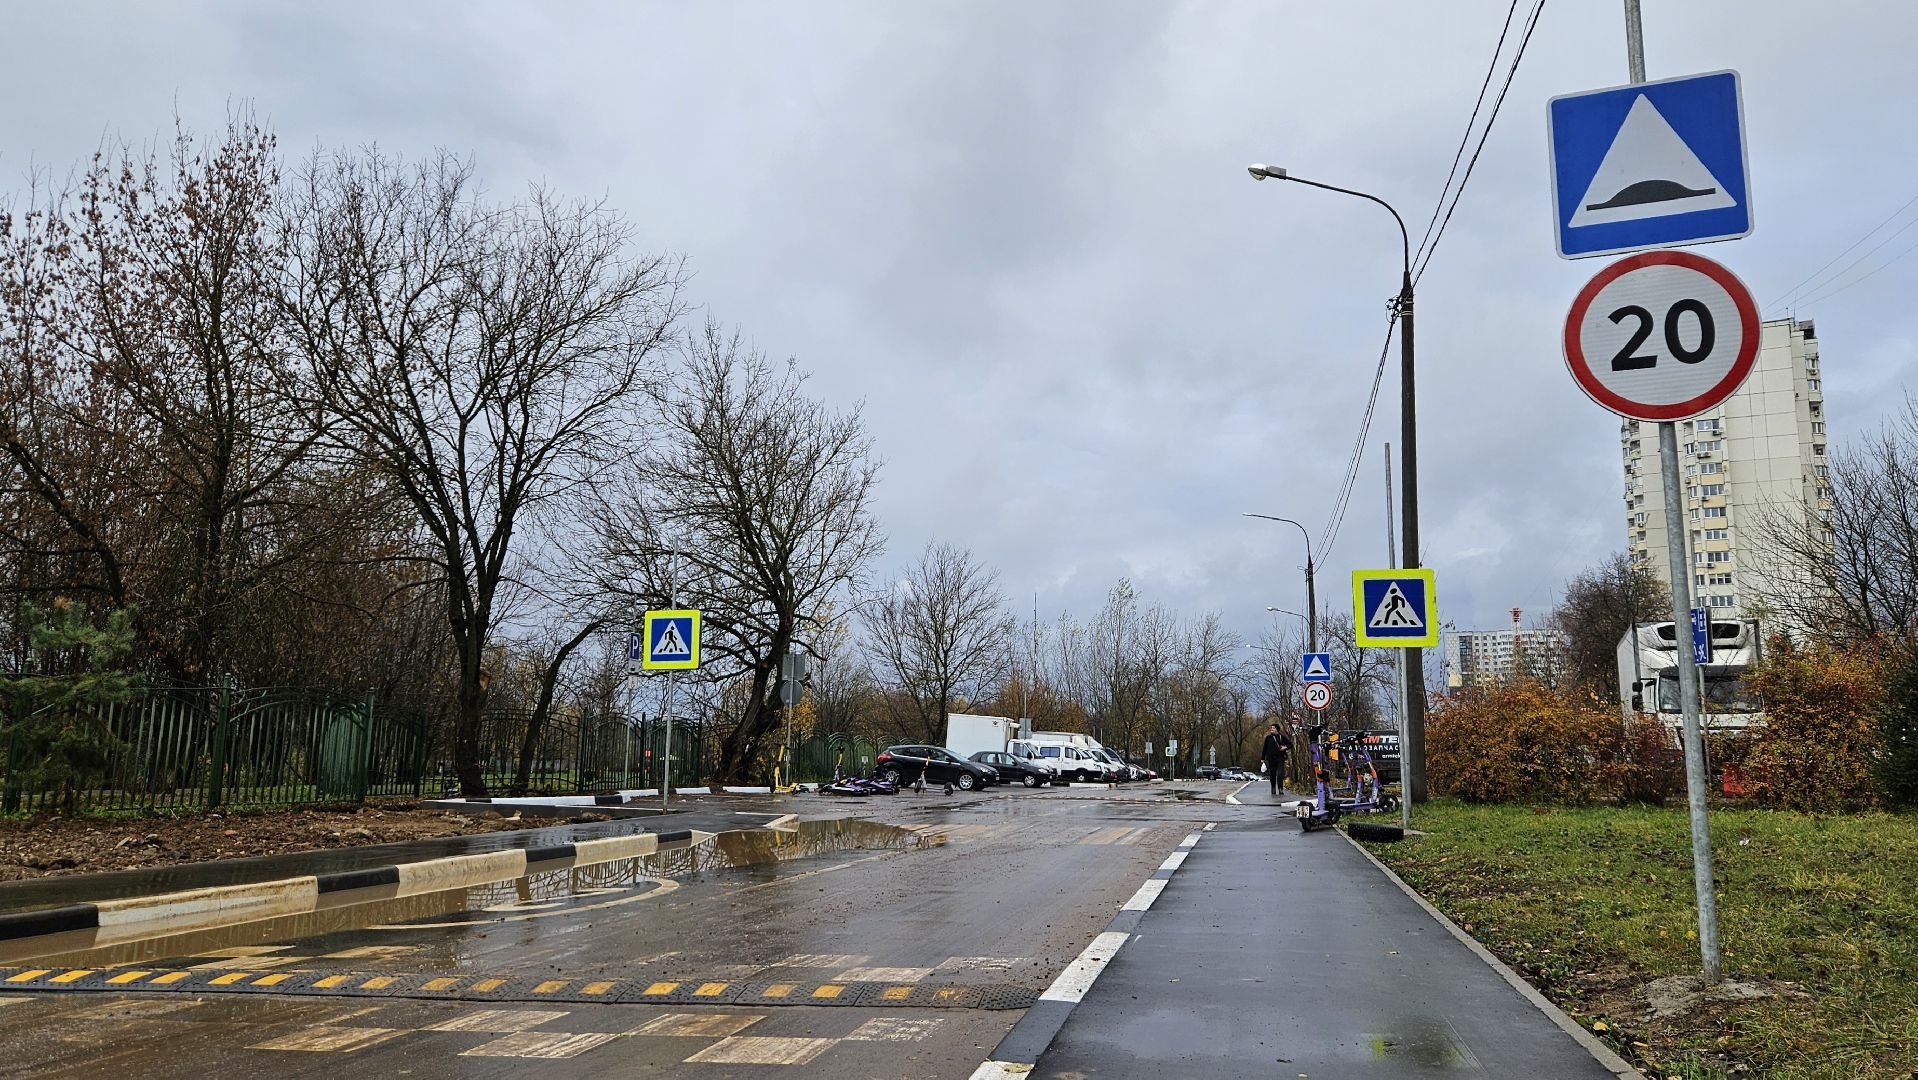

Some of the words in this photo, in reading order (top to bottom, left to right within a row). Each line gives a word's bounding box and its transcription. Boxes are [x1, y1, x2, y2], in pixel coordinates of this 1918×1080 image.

[1608, 298, 1715, 372] 20
[632, 636, 638, 656] P
[1310, 690, 1325, 700] 20
